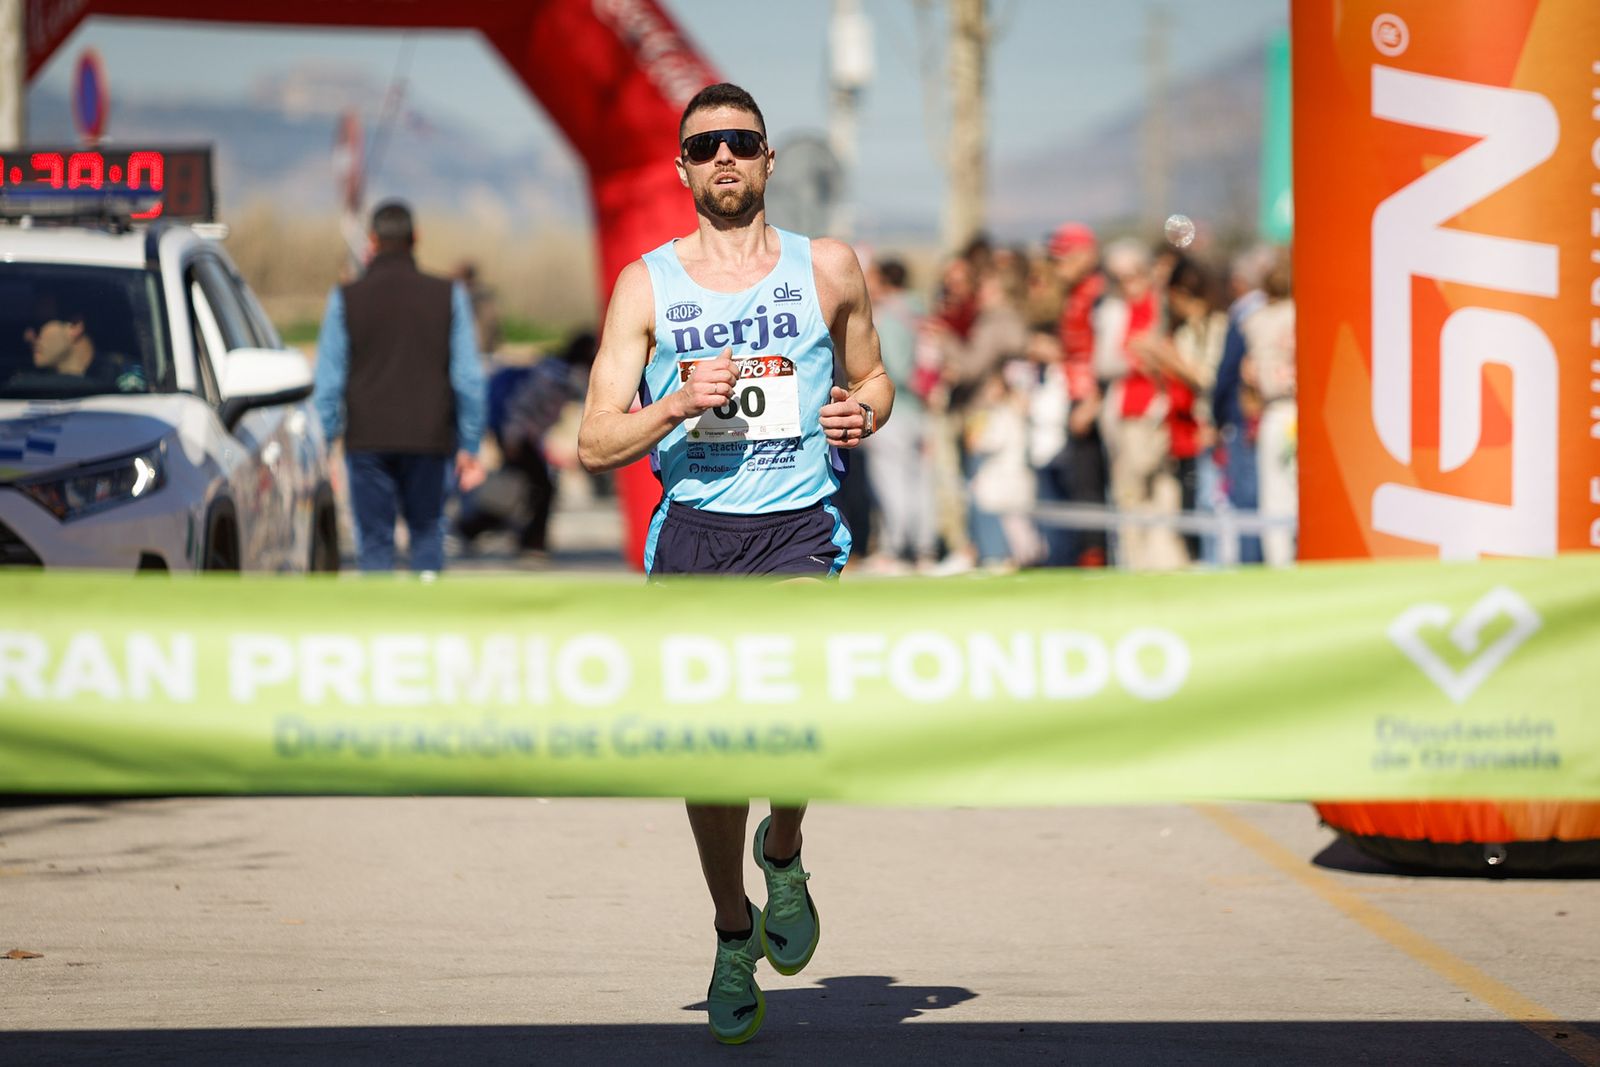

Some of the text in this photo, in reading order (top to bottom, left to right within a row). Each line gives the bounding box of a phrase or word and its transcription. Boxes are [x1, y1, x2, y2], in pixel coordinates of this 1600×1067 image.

[773, 282, 802, 302] als
[667, 304, 702, 320] TROPS
[672, 305, 799, 353] nerja
[229, 632, 631, 706] PREMIO
[660, 633, 801, 701] DE
[827, 628, 1191, 701] FONDO
